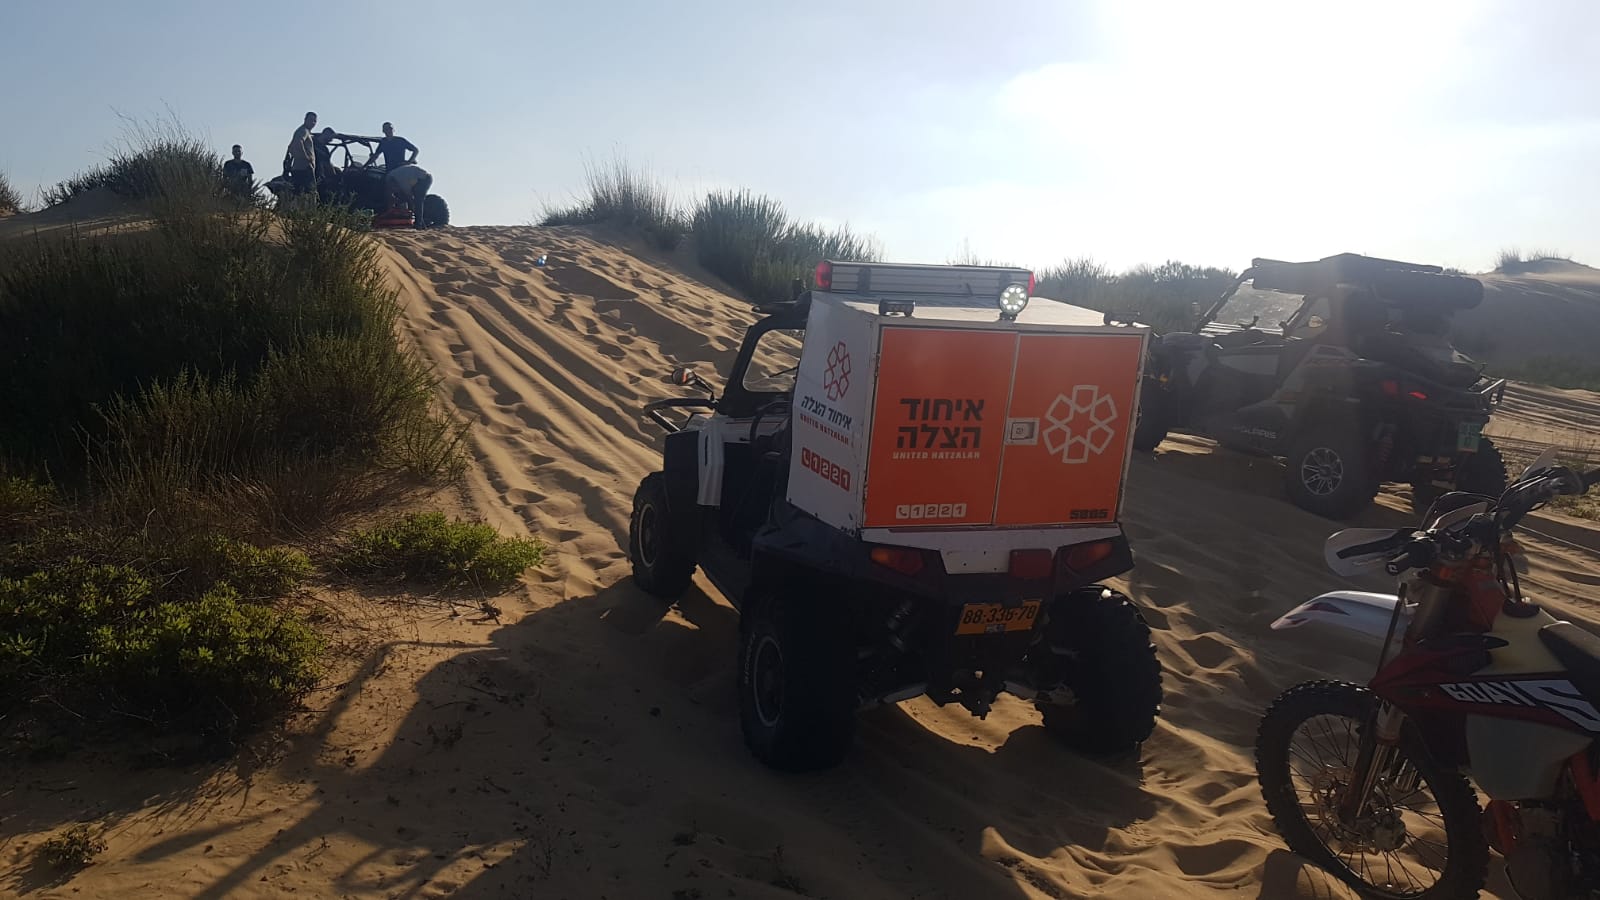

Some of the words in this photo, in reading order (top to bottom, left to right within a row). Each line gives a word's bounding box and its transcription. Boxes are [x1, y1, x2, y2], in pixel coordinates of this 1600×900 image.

[801, 395, 827, 417] הצלה
[900, 398, 985, 421] איחוד
[828, 407, 852, 430] איחוד
[896, 423, 982, 449] הצלה
[893, 451, 929, 459] UNITED
[931, 451, 980, 459] HATZALAH
[812, 454, 850, 490] 1221
[911, 504, 966, 518] 1221
